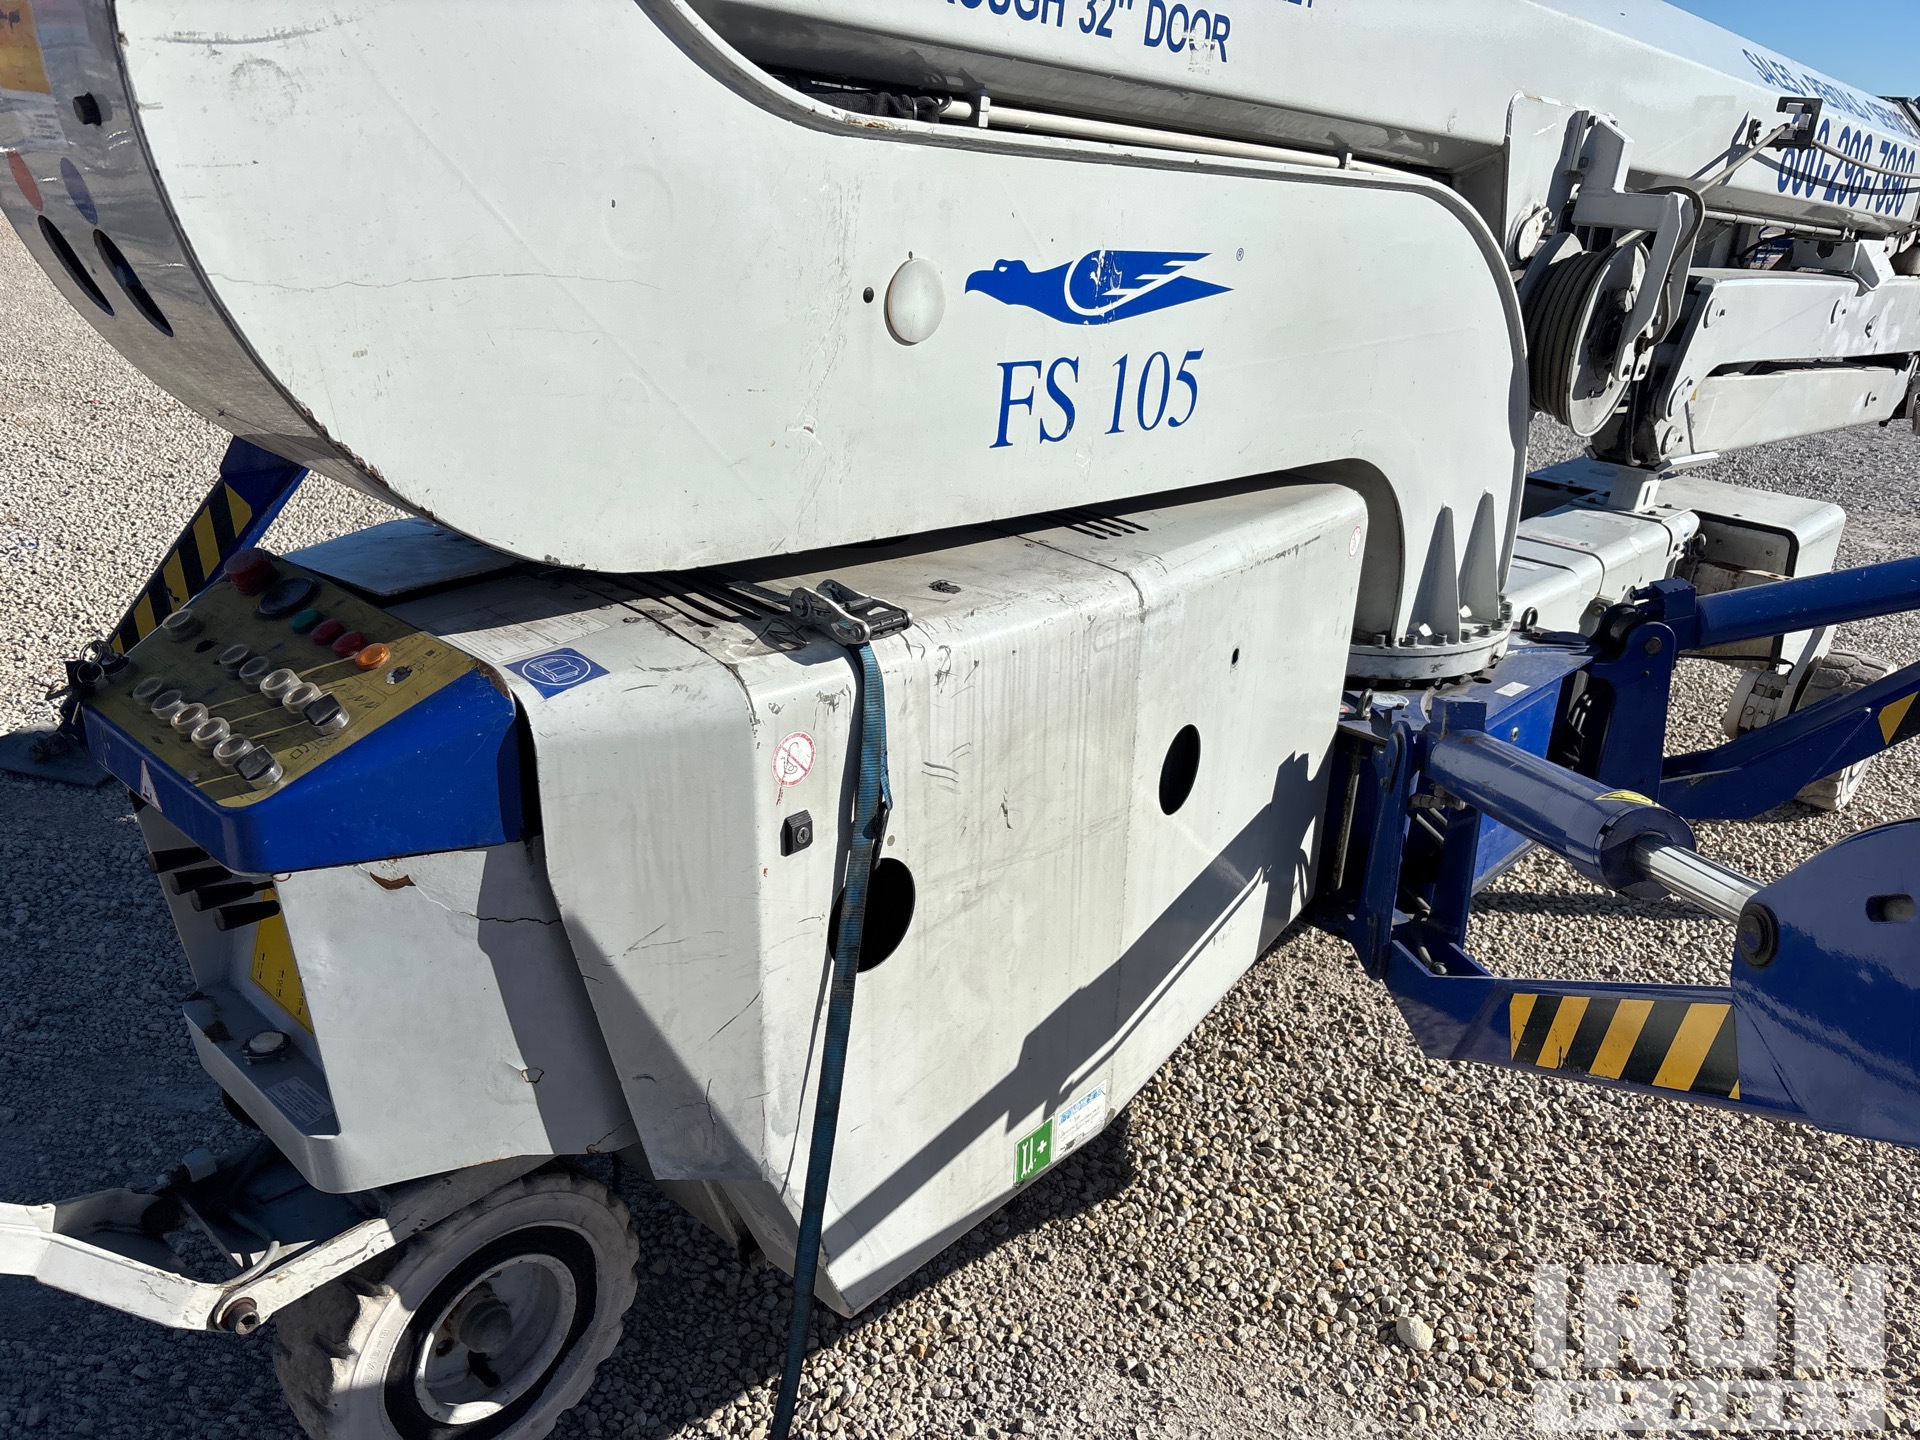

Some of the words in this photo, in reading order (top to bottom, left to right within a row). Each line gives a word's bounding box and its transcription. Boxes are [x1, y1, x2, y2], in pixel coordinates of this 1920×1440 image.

[1143, 0, 1231, 62] DOOR
[1741, 48, 1807, 97] SALES
[989, 356, 1079, 448] FS
[1104, 348, 1205, 435] 105
